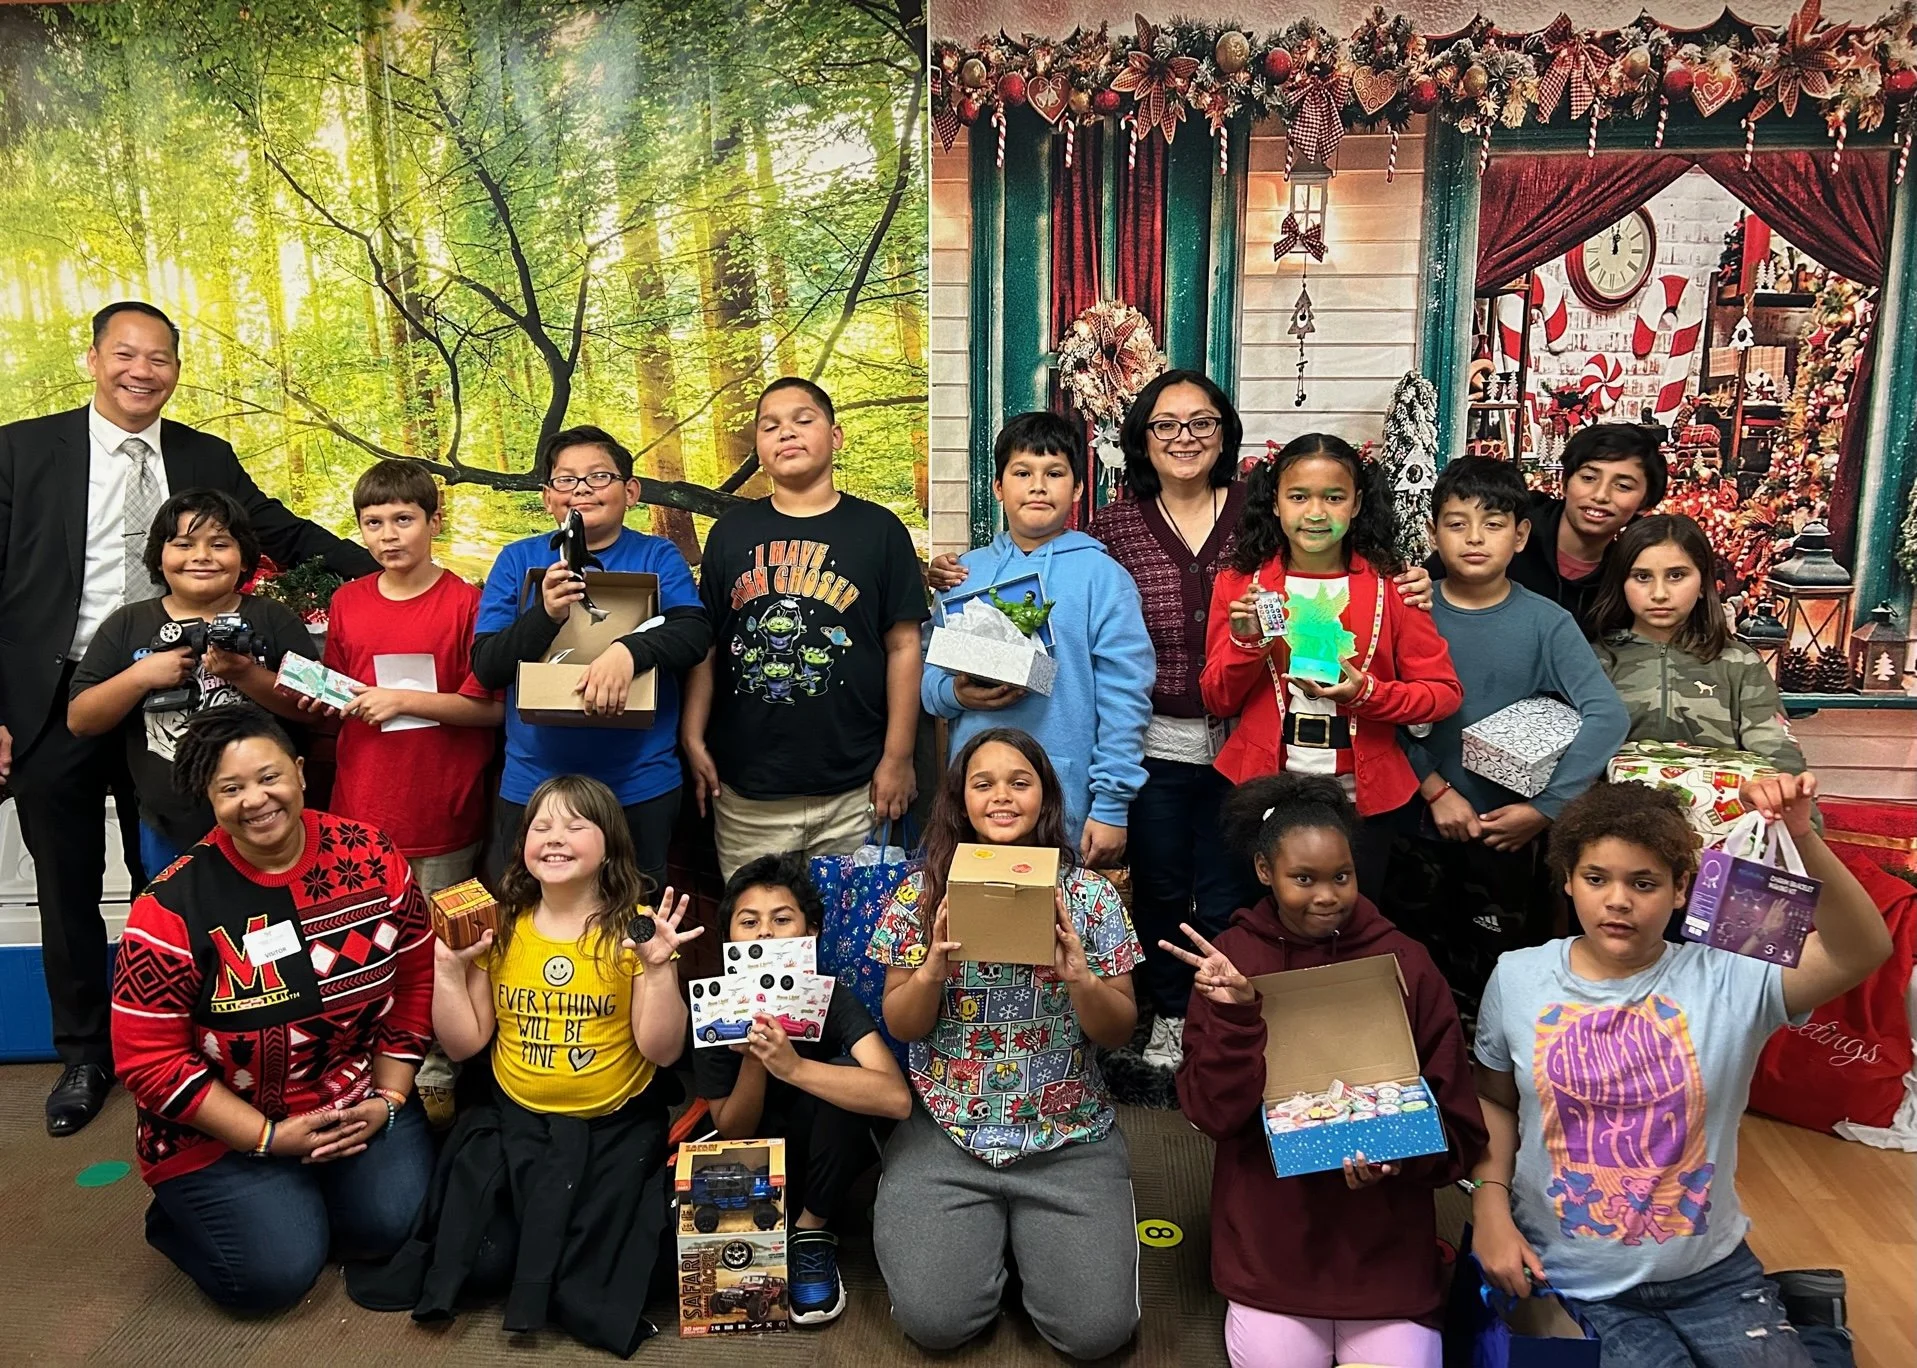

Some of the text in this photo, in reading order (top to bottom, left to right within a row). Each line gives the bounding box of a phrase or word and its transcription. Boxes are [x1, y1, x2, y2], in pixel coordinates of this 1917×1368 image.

[755, 539, 830, 569] I HAVE
[773, 565, 860, 614] CHOSEN
[264, 946, 287, 958] VISITOR
[498, 984, 616, 1017] EVERYTHING
[516, 1014, 585, 1043] WILL BE
[521, 1040, 558, 1069] FINE
[1145, 1226, 1175, 1239] 8
[681, 1253, 702, 1320] SAFARI
[701, 1251, 717, 1294] RACER
